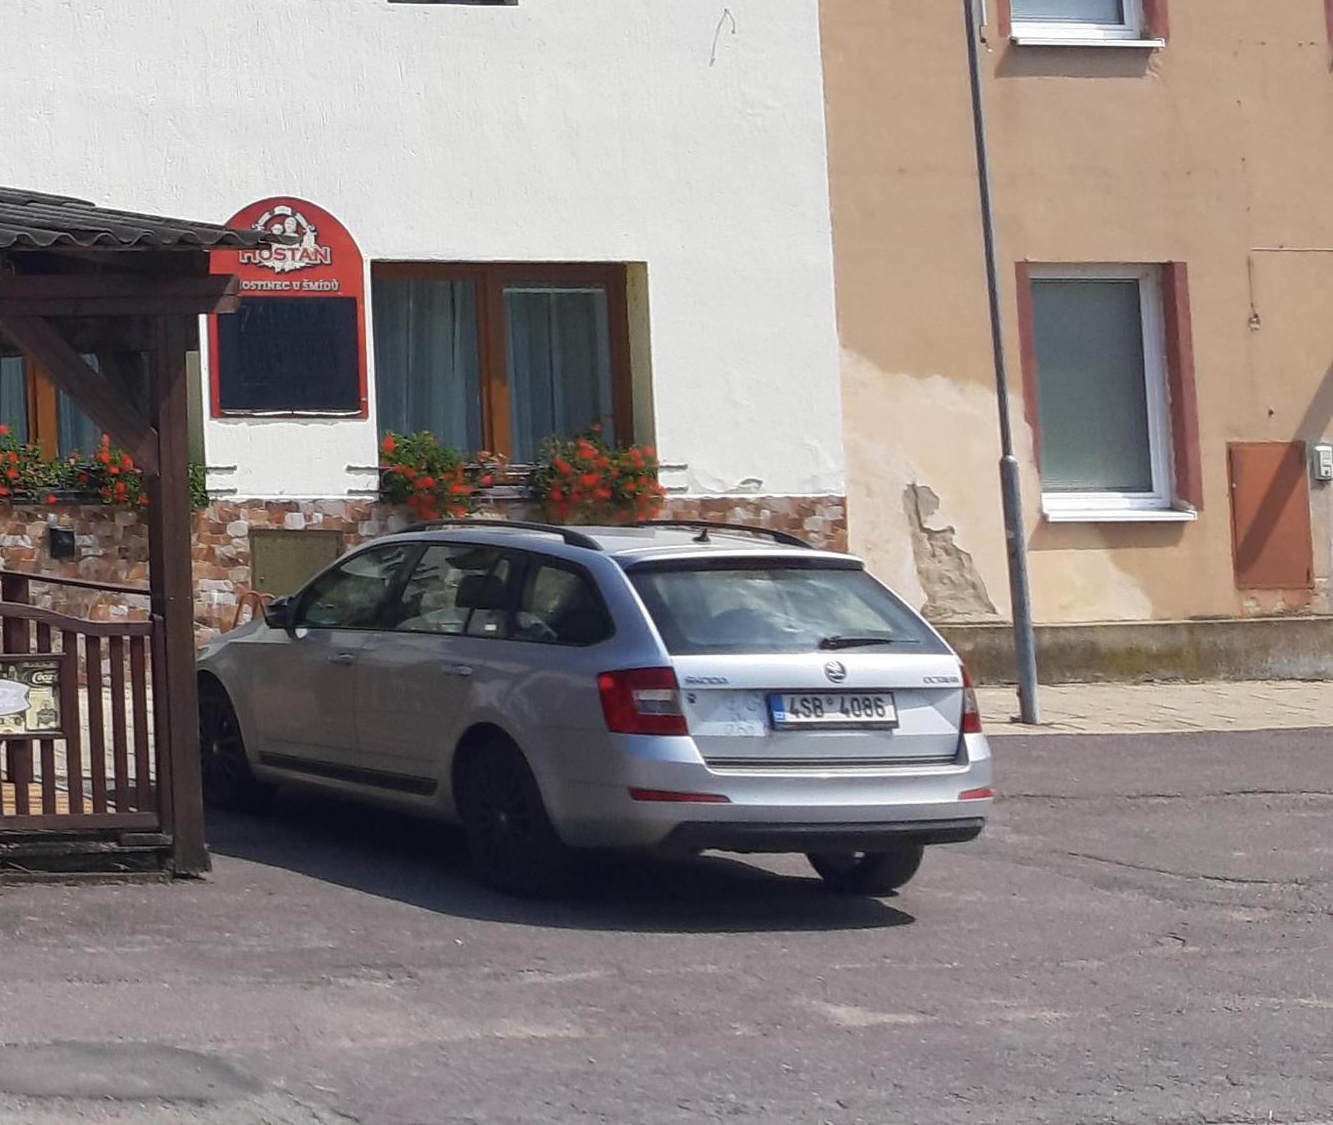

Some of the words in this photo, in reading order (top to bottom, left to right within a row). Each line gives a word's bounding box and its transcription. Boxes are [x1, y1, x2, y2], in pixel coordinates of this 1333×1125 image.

[240, 280, 290, 291] OSTINEC
[293, 281, 301, 291] U
[302, 279, 339, 291] ŠMÍDŮ
[789, 696, 824, 718] 4SB
[840, 696, 886, 718] 4086
